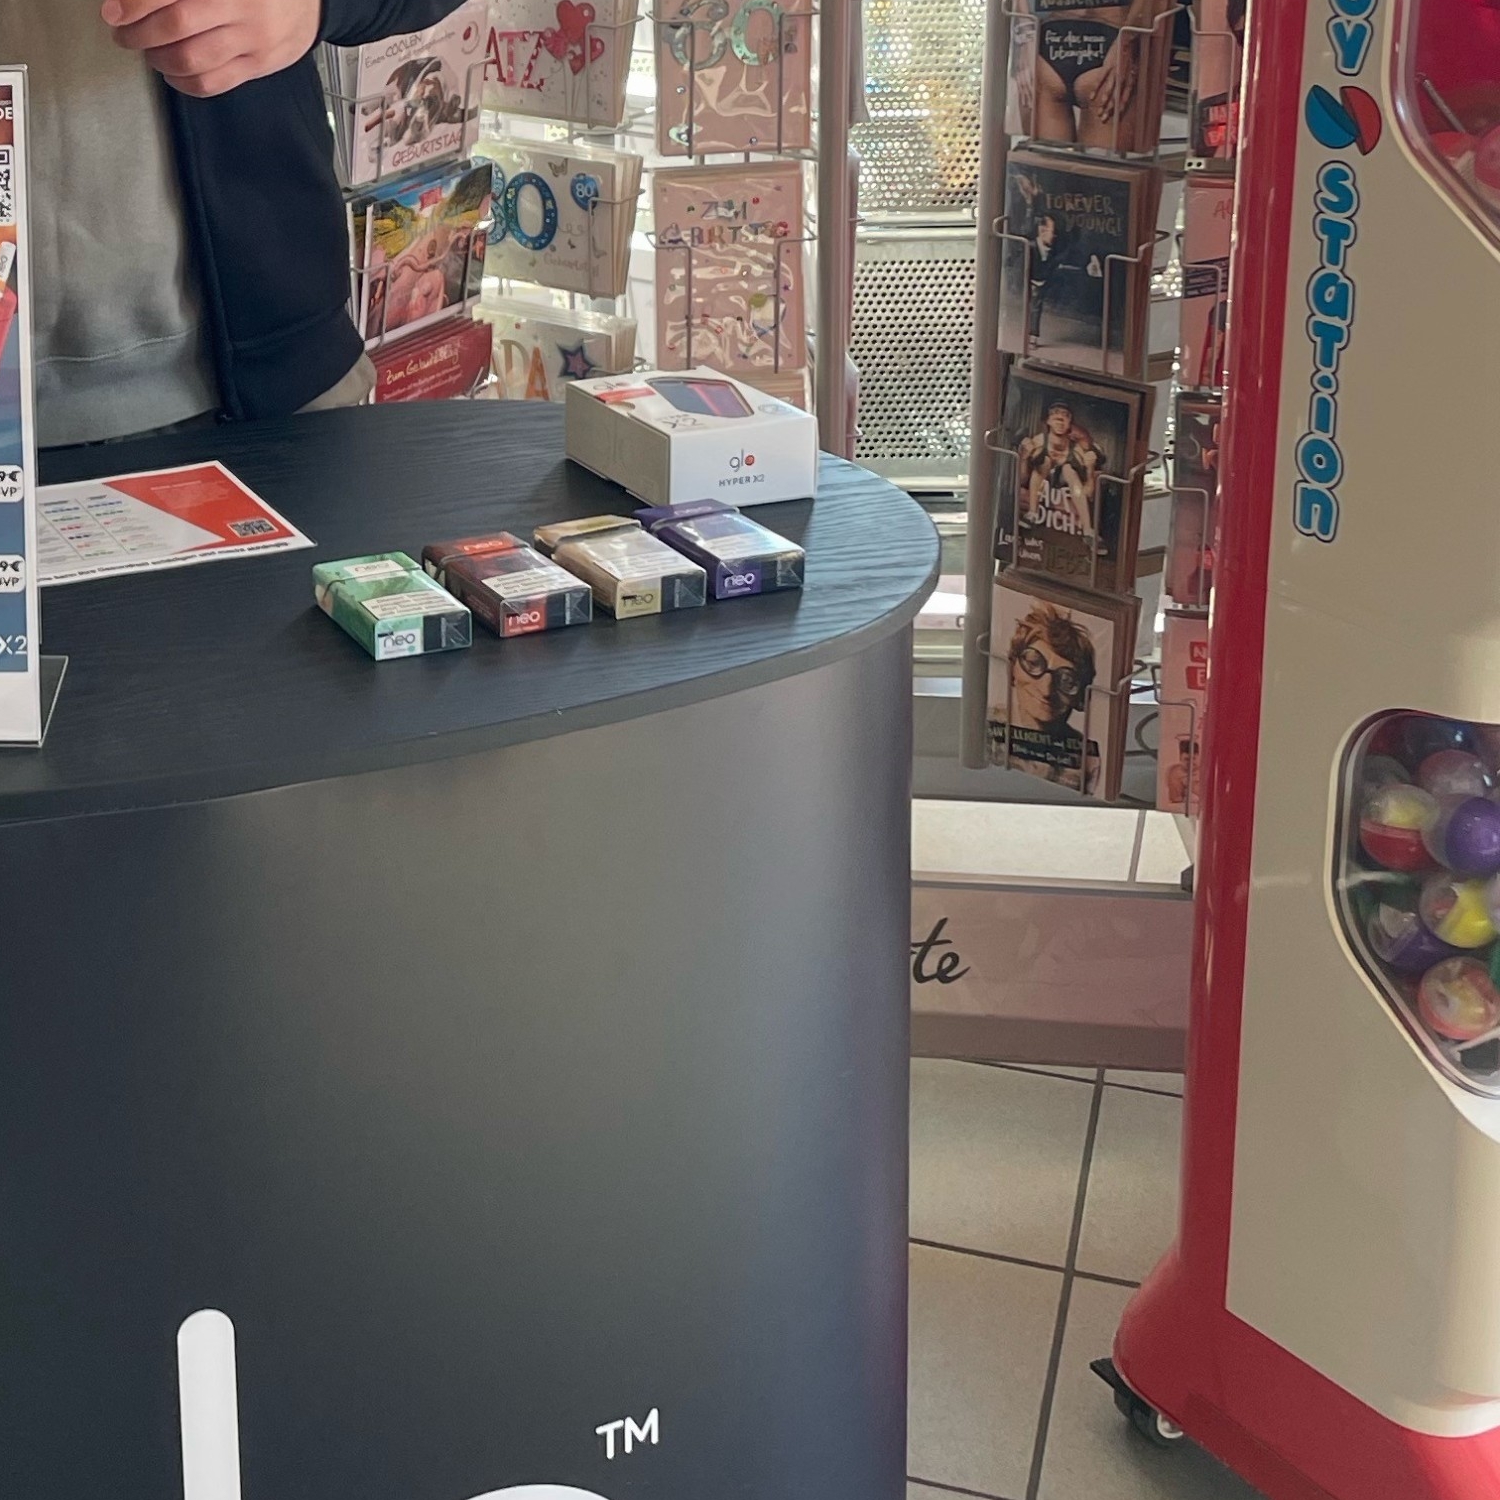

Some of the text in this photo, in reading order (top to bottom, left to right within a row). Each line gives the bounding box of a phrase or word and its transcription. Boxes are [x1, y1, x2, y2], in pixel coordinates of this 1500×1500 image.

[386, 32, 423, 57] COOLEN
[483, 26, 547, 92] ATZ
[392, 130, 463, 168] GEBURTSTAG
[574, 182, 593, 199] 80
[1045, 192, 1115, 216] FOREVER
[386, 365, 406, 385] Zum
[406, 340, 462, 379] Geburtstag
[728, 448, 756, 472] glo
[717, 474, 765, 488] HYPER X2
[464, 538, 505, 552] neo
[724, 572, 756, 588] neo
[622, 592, 655, 608] neo
[507, 609, 542, 626] neo
[382, 631, 416, 650] neo
[595, 1407, 659, 1460] TM
